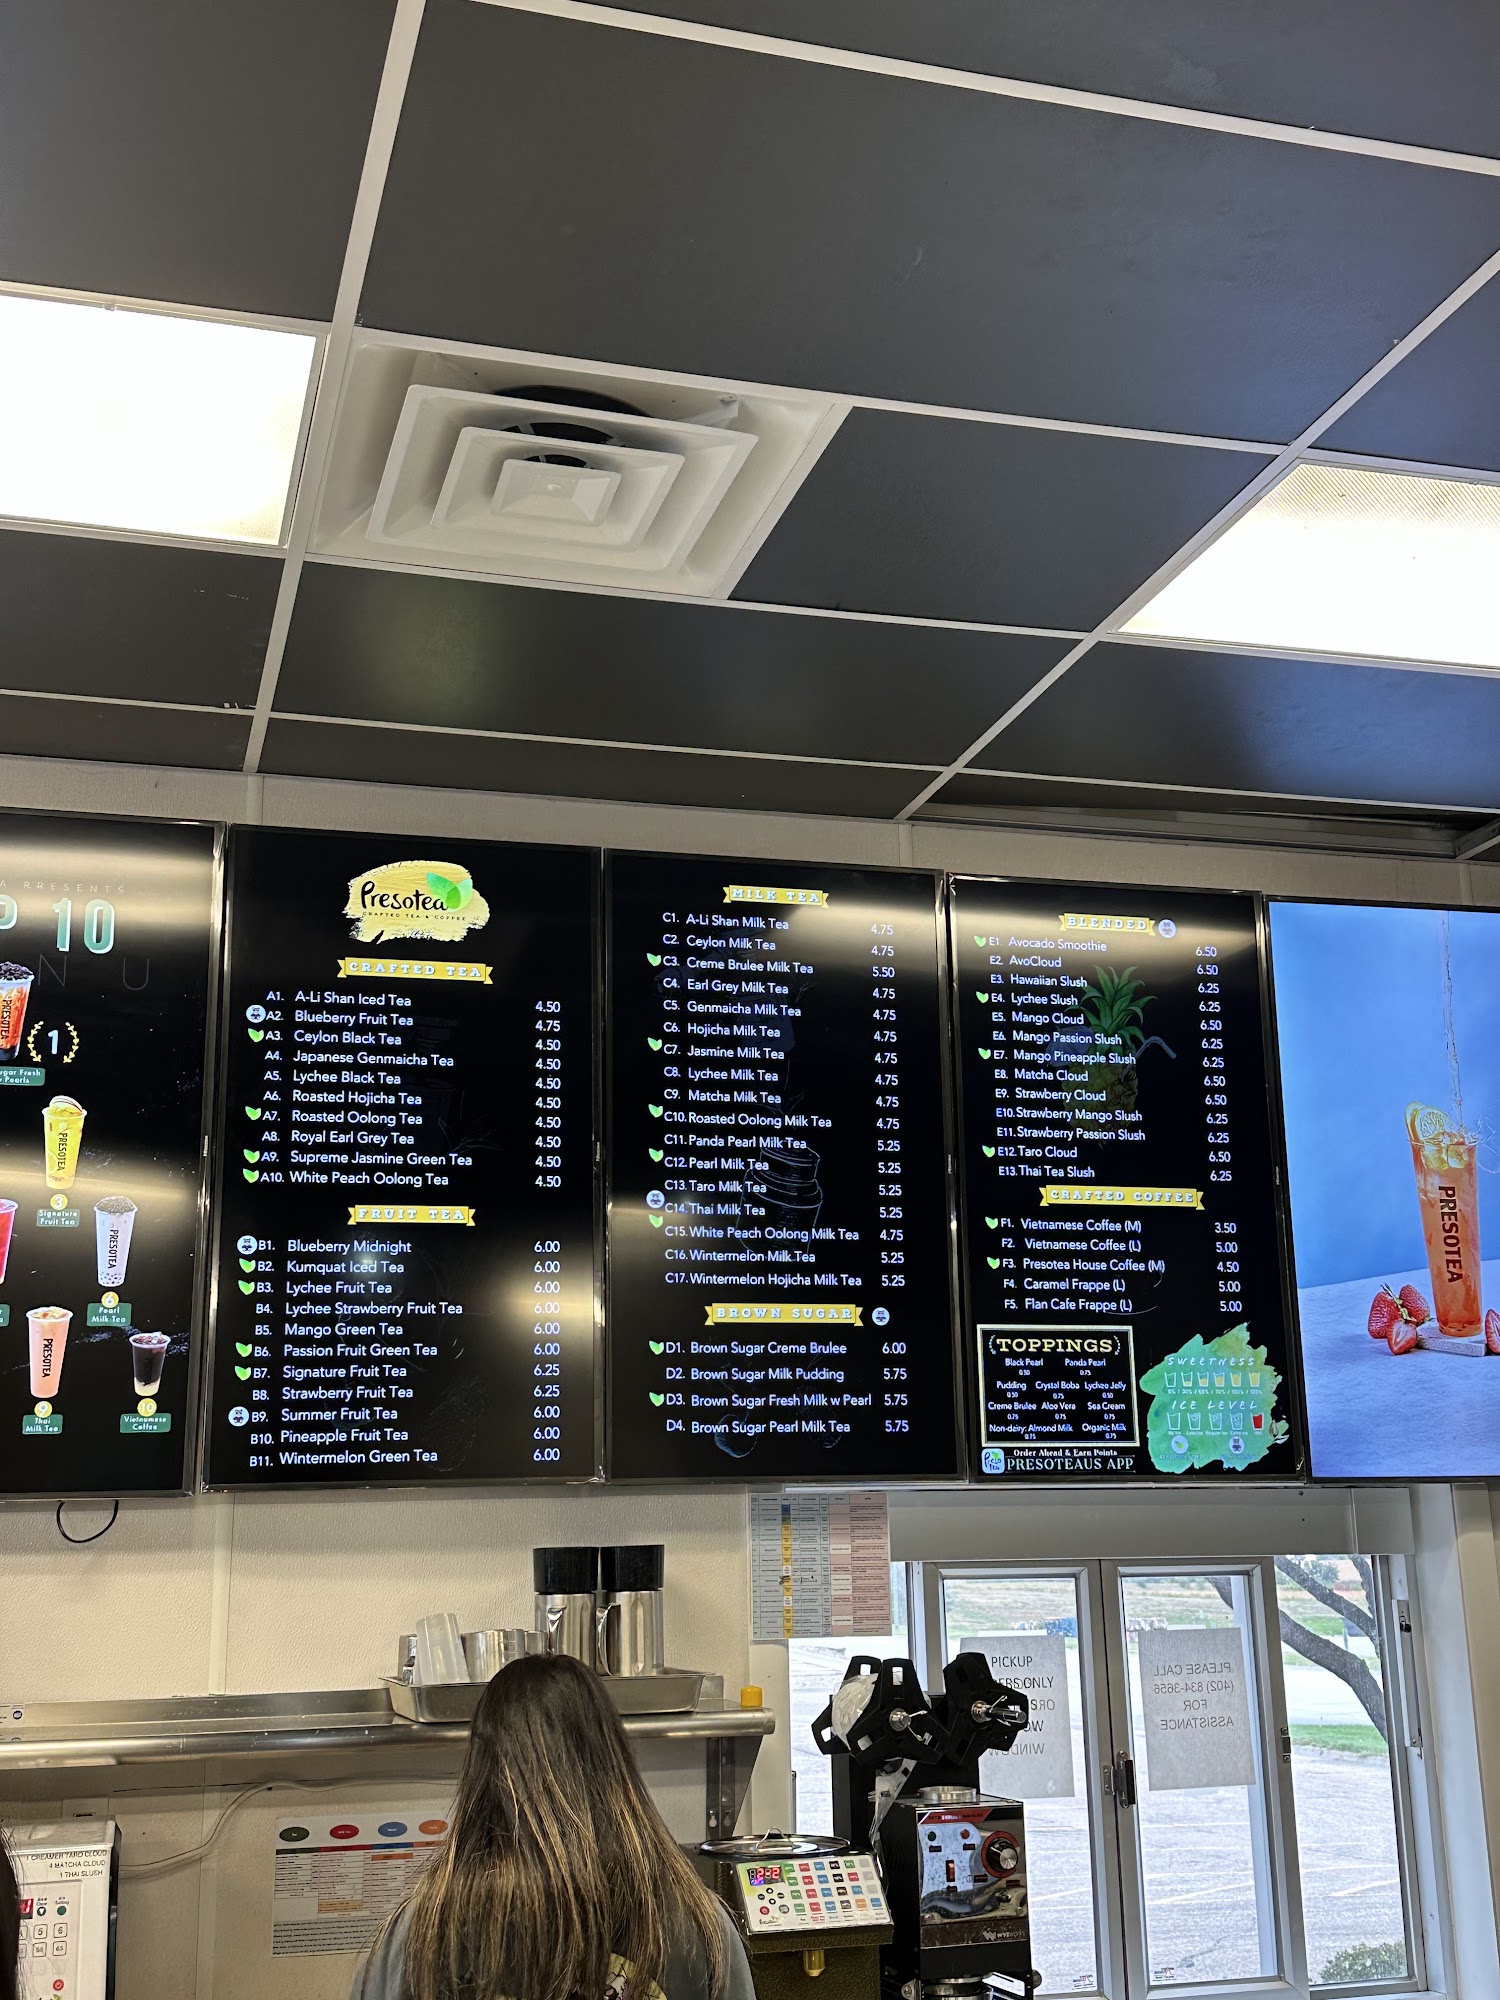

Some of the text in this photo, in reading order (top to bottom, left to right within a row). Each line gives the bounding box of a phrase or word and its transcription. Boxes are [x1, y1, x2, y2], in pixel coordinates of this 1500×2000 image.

[360, 880, 449, 911] Presotea
[732, 888, 820, 903] MILK TEA
[52, 897, 115, 954] 10
[1067, 916, 1147, 930] BLENDED
[348, 962, 482, 978] CRAFTED TEA
[662, 955, 895, 977] C3. Creme Brulee Milk Tea 5.50
[266, 1008, 560, 1031] A2. Blueberry Fruit Tea 4.75
[991, 1010, 1222, 1030] E5. Mango Cloud 6.50
[48, 1030, 58, 1054] 1
[993, 1048, 1224, 1068] E7. Mango Pineapple Slush 6.25
[261, 1129, 561, 1148] A8. Royal Earl Grey Tea 4.50
[56, 1132, 68, 1172] PRESOTEA
[260, 1170, 561, 1187] A10. White Peach Oolong Tea 4.50
[55, 1196, 63, 1209] 3
[1050, 1190, 1194, 1203] CRAFTED COFFEE
[38, 1210, 78, 1218] Signature
[358, 1208, 466, 1220] FRUIT TEA
[40, 1218, 60, 1226] Fruit
[1438, 1186, 1464, 1283] PRESOTEA
[108, 1229, 119, 1269] PRESOTEA
[258, 1238, 560, 1255] B1. Blueberry Midnight 6.00
[1002, 1257, 1239, 1273] F3. Presotea House Coffee (M) 4.50
[664, 1272, 905, 1288] C17. Wintermelon Hojicha Milk Tea 5.25
[1003, 1277, 1240, 1292] F4. Caramel Frappe (L) 5.00
[106, 1294, 115, 1306] 6
[98, 1306, 120, 1314] Pearl
[255, 1301, 560, 1317] B4. Lychee Strawberry Fruit Tea 6.00
[716, 1307, 852, 1319] BROWN SUGAR
[91, 1314, 126, 1324] Milk Tea
[665, 1341, 906, 1356] D1. Brown Sugar Creme Brulee 6.00
[996, 1338, 1113, 1352] TOPPINGS
[42, 1338, 54, 1378] PRESOTEA
[1168, 1357, 1255, 1366] SWEETNESS
[253, 1363, 559, 1381] B7. Signature Fruit Tea 6.25
[996, 1381, 1027, 1391] Pudding
[1035, 1381, 1060, 1391] Crystal
[1110, 1382, 1126, 1391] Jelly
[38, 1404, 48, 1415] 9
[140, 1402, 154, 1413] 10
[1102, 1402, 1125, 1410] Cream
[1172, 1400, 1258, 1410] ICE LEVEL
[124, 1416, 167, 1424] Vietnamese
[132, 1423, 158, 1431] Coffee
[26, 1424, 58, 1433] Milk Tea
[1007, 1458, 1102, 1470] PRESOTEAUS
[1107, 1458, 1134, 1470] APP
[992, 1656, 1033, 1668] PICKUP
